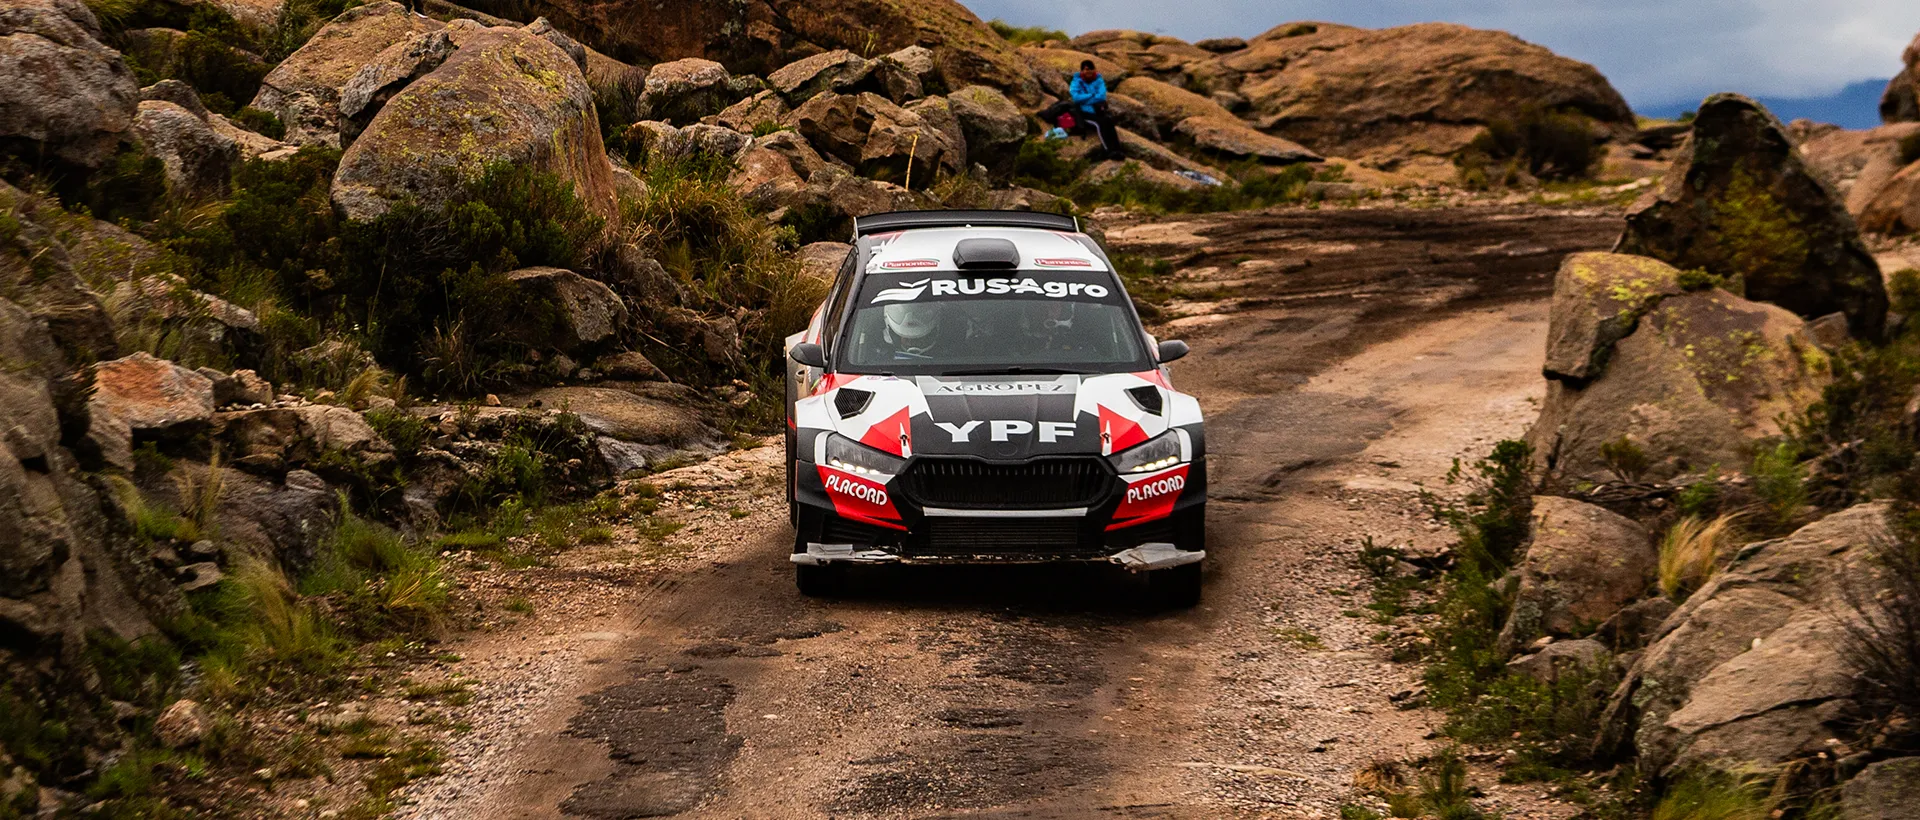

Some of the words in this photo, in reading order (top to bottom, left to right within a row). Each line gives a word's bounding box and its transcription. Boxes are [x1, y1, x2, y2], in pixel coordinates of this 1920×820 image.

[936, 383, 1064, 394] AGROPEZ
[934, 420, 1077, 443] YPF
[825, 474, 887, 506] PLACORD
[1127, 474, 1185, 504] PLACORD
